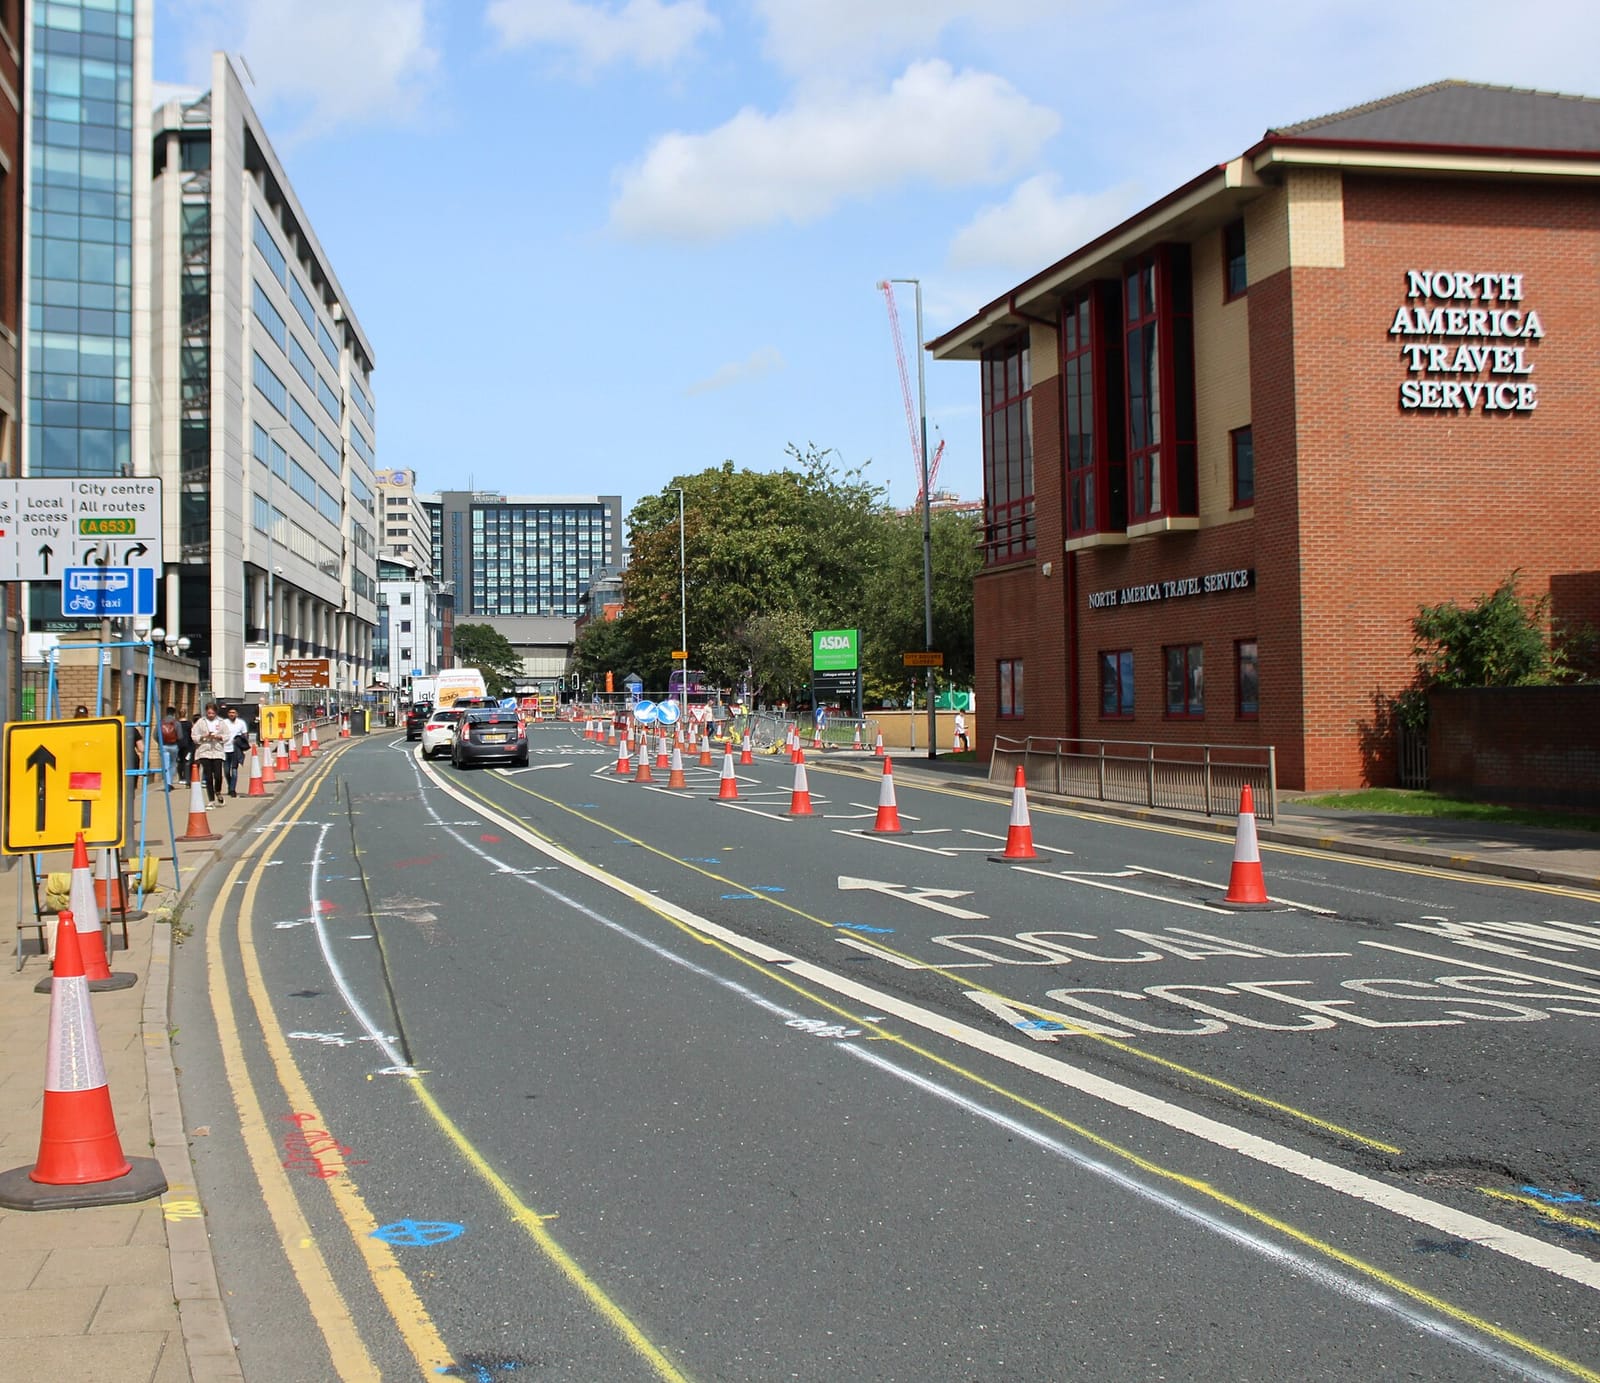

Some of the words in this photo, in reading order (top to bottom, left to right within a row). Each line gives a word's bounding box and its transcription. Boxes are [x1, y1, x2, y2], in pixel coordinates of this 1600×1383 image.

[1407, 270, 1524, 300] NORTH
[1390, 306, 1546, 338] AMERICA
[1403, 344, 1534, 374] TRAVEL
[1401, 380, 1538, 410] SERVICE
[79, 483, 106, 496] City
[111, 484, 155, 495] centre
[28, 497, 64, 508] Local
[79, 501, 97, 512] All
[103, 502, 146, 512] routes
[22, 513, 68, 522] access
[31, 526, 60, 538] only
[80, 520, 134, 533] (A653)
[1088, 590, 1117, 608] NORTH
[1120, 584, 1161, 605] AMERICA
[1163, 578, 1201, 599] TRAVEL
[1204, 569, 1248, 593] SERVICE
[101, 598, 121, 608] taxi
[819, 636, 850, 650] ASDA
[835, 927, 1352, 971] LOCAL
[964, 975, 1600, 1041] ACCESS
